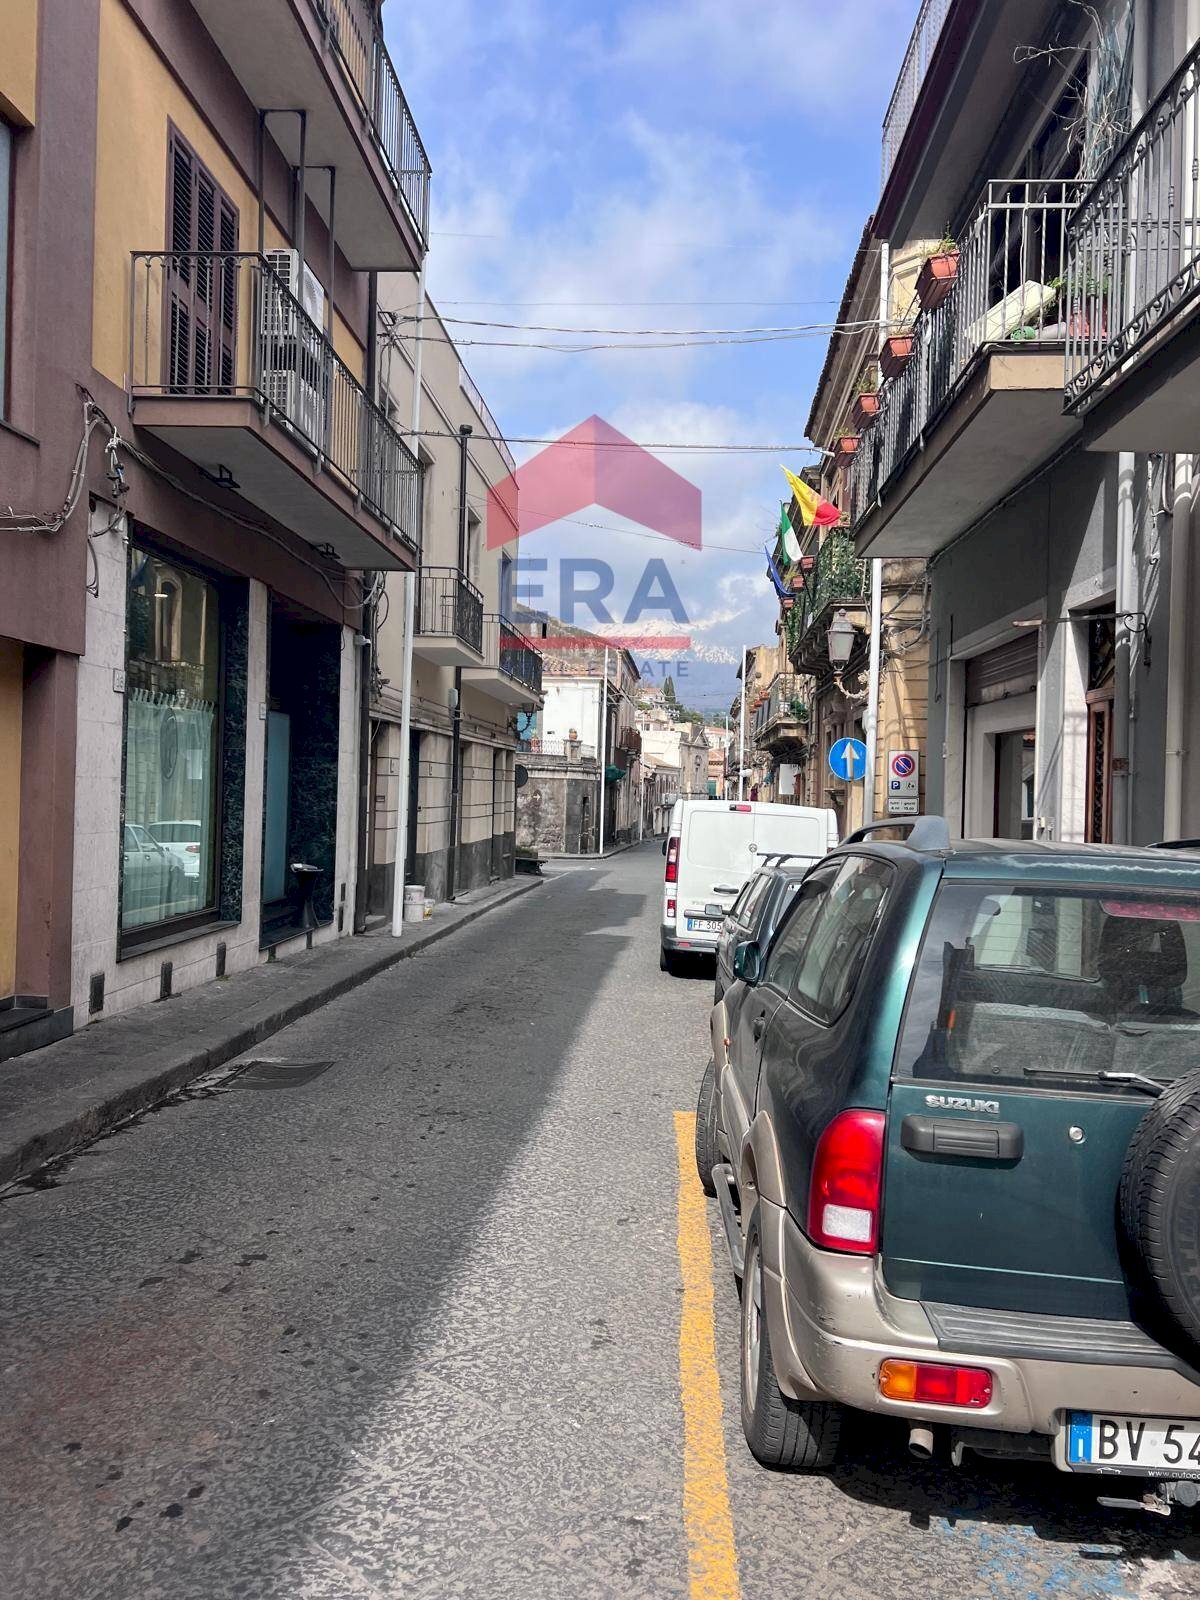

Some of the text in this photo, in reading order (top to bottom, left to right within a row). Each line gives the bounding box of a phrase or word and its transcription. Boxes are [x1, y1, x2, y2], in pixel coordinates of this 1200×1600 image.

[693, 920, 703, 929] FF
[924, 1095, 1000, 1114] SUZUKI
[1099, 1420, 1146, 1461] BV
